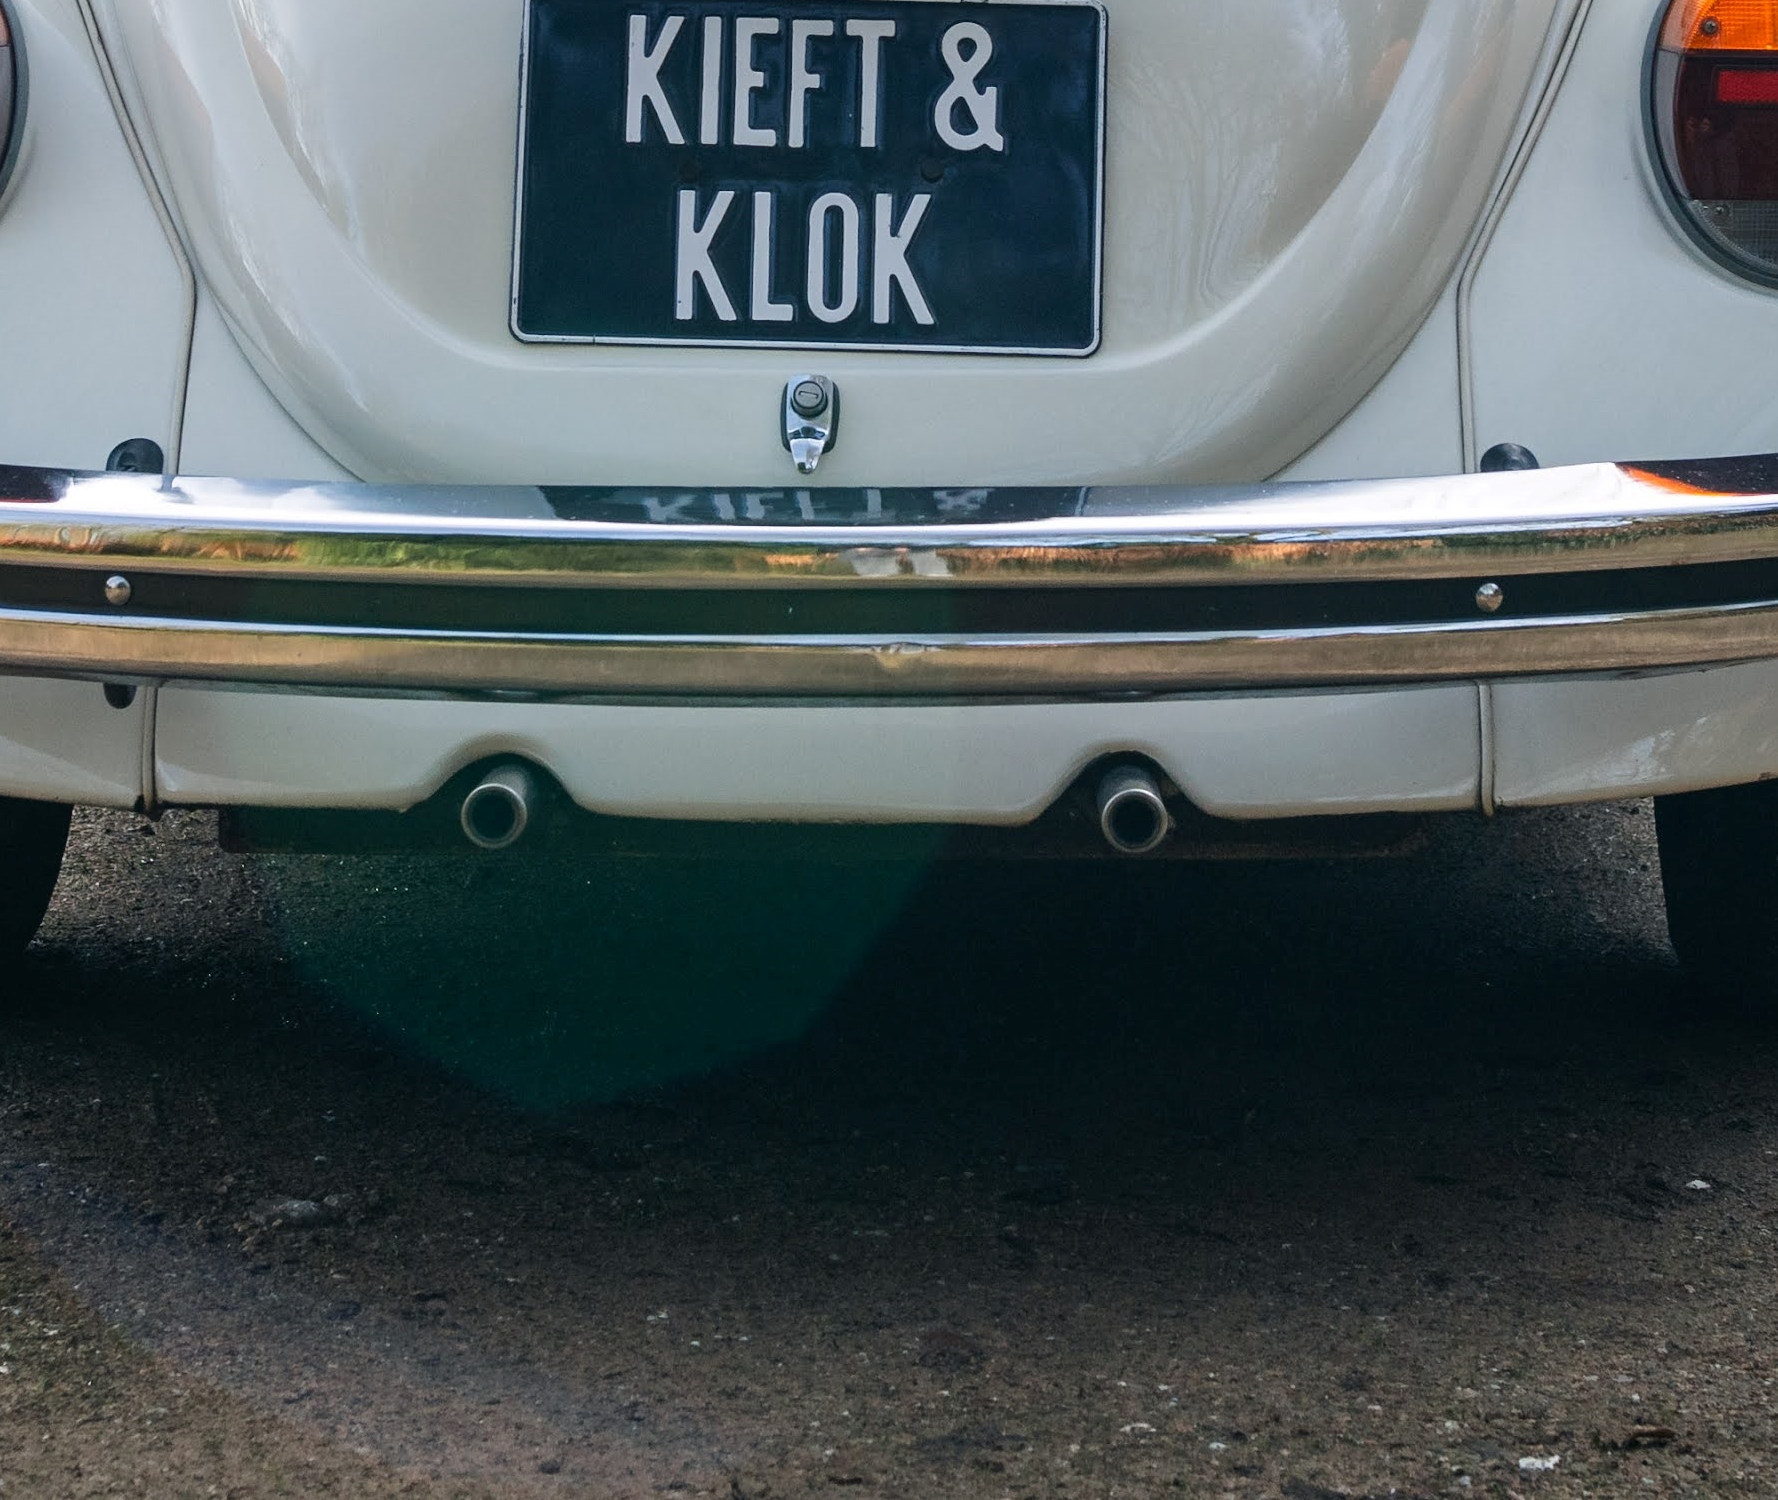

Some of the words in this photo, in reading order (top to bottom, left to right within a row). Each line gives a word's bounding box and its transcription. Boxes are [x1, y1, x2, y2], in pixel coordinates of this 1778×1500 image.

[625, 14, 896, 148] KIEFT
[934, 21, 1004, 152] &
[675, 189, 935, 325] KLOK
